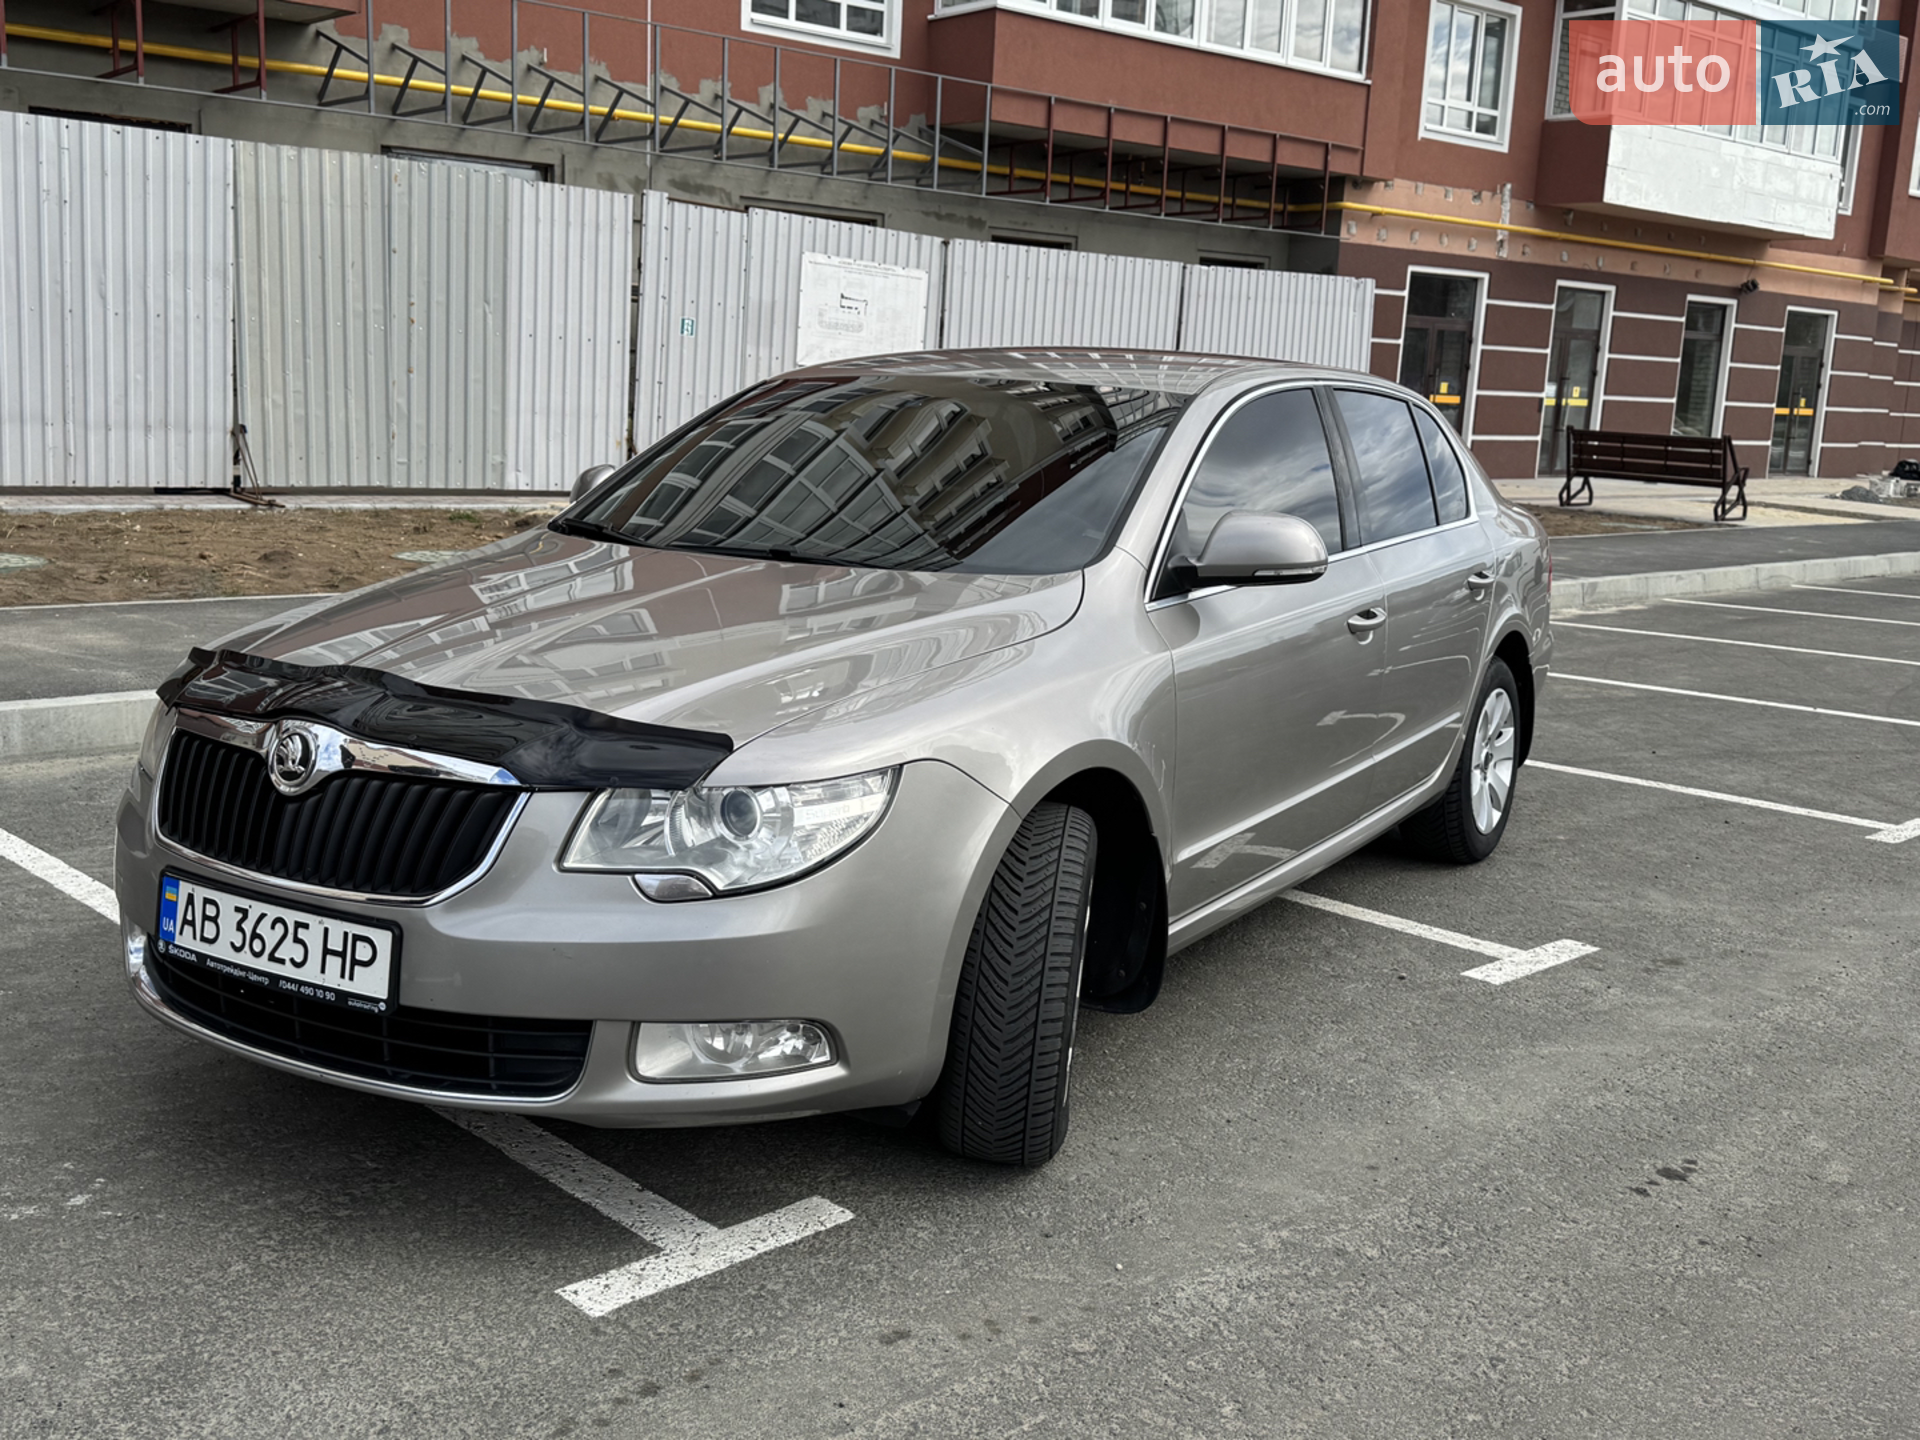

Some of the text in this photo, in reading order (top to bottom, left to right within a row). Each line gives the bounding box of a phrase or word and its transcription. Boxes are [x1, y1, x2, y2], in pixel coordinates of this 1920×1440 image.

[163, 916, 175, 934] UA
[179, 892, 378, 982] AB 3625 HP
[300, 985, 314, 996] 490
[315, 988, 325, 999] 10
[325, 991, 335, 1001] 90
